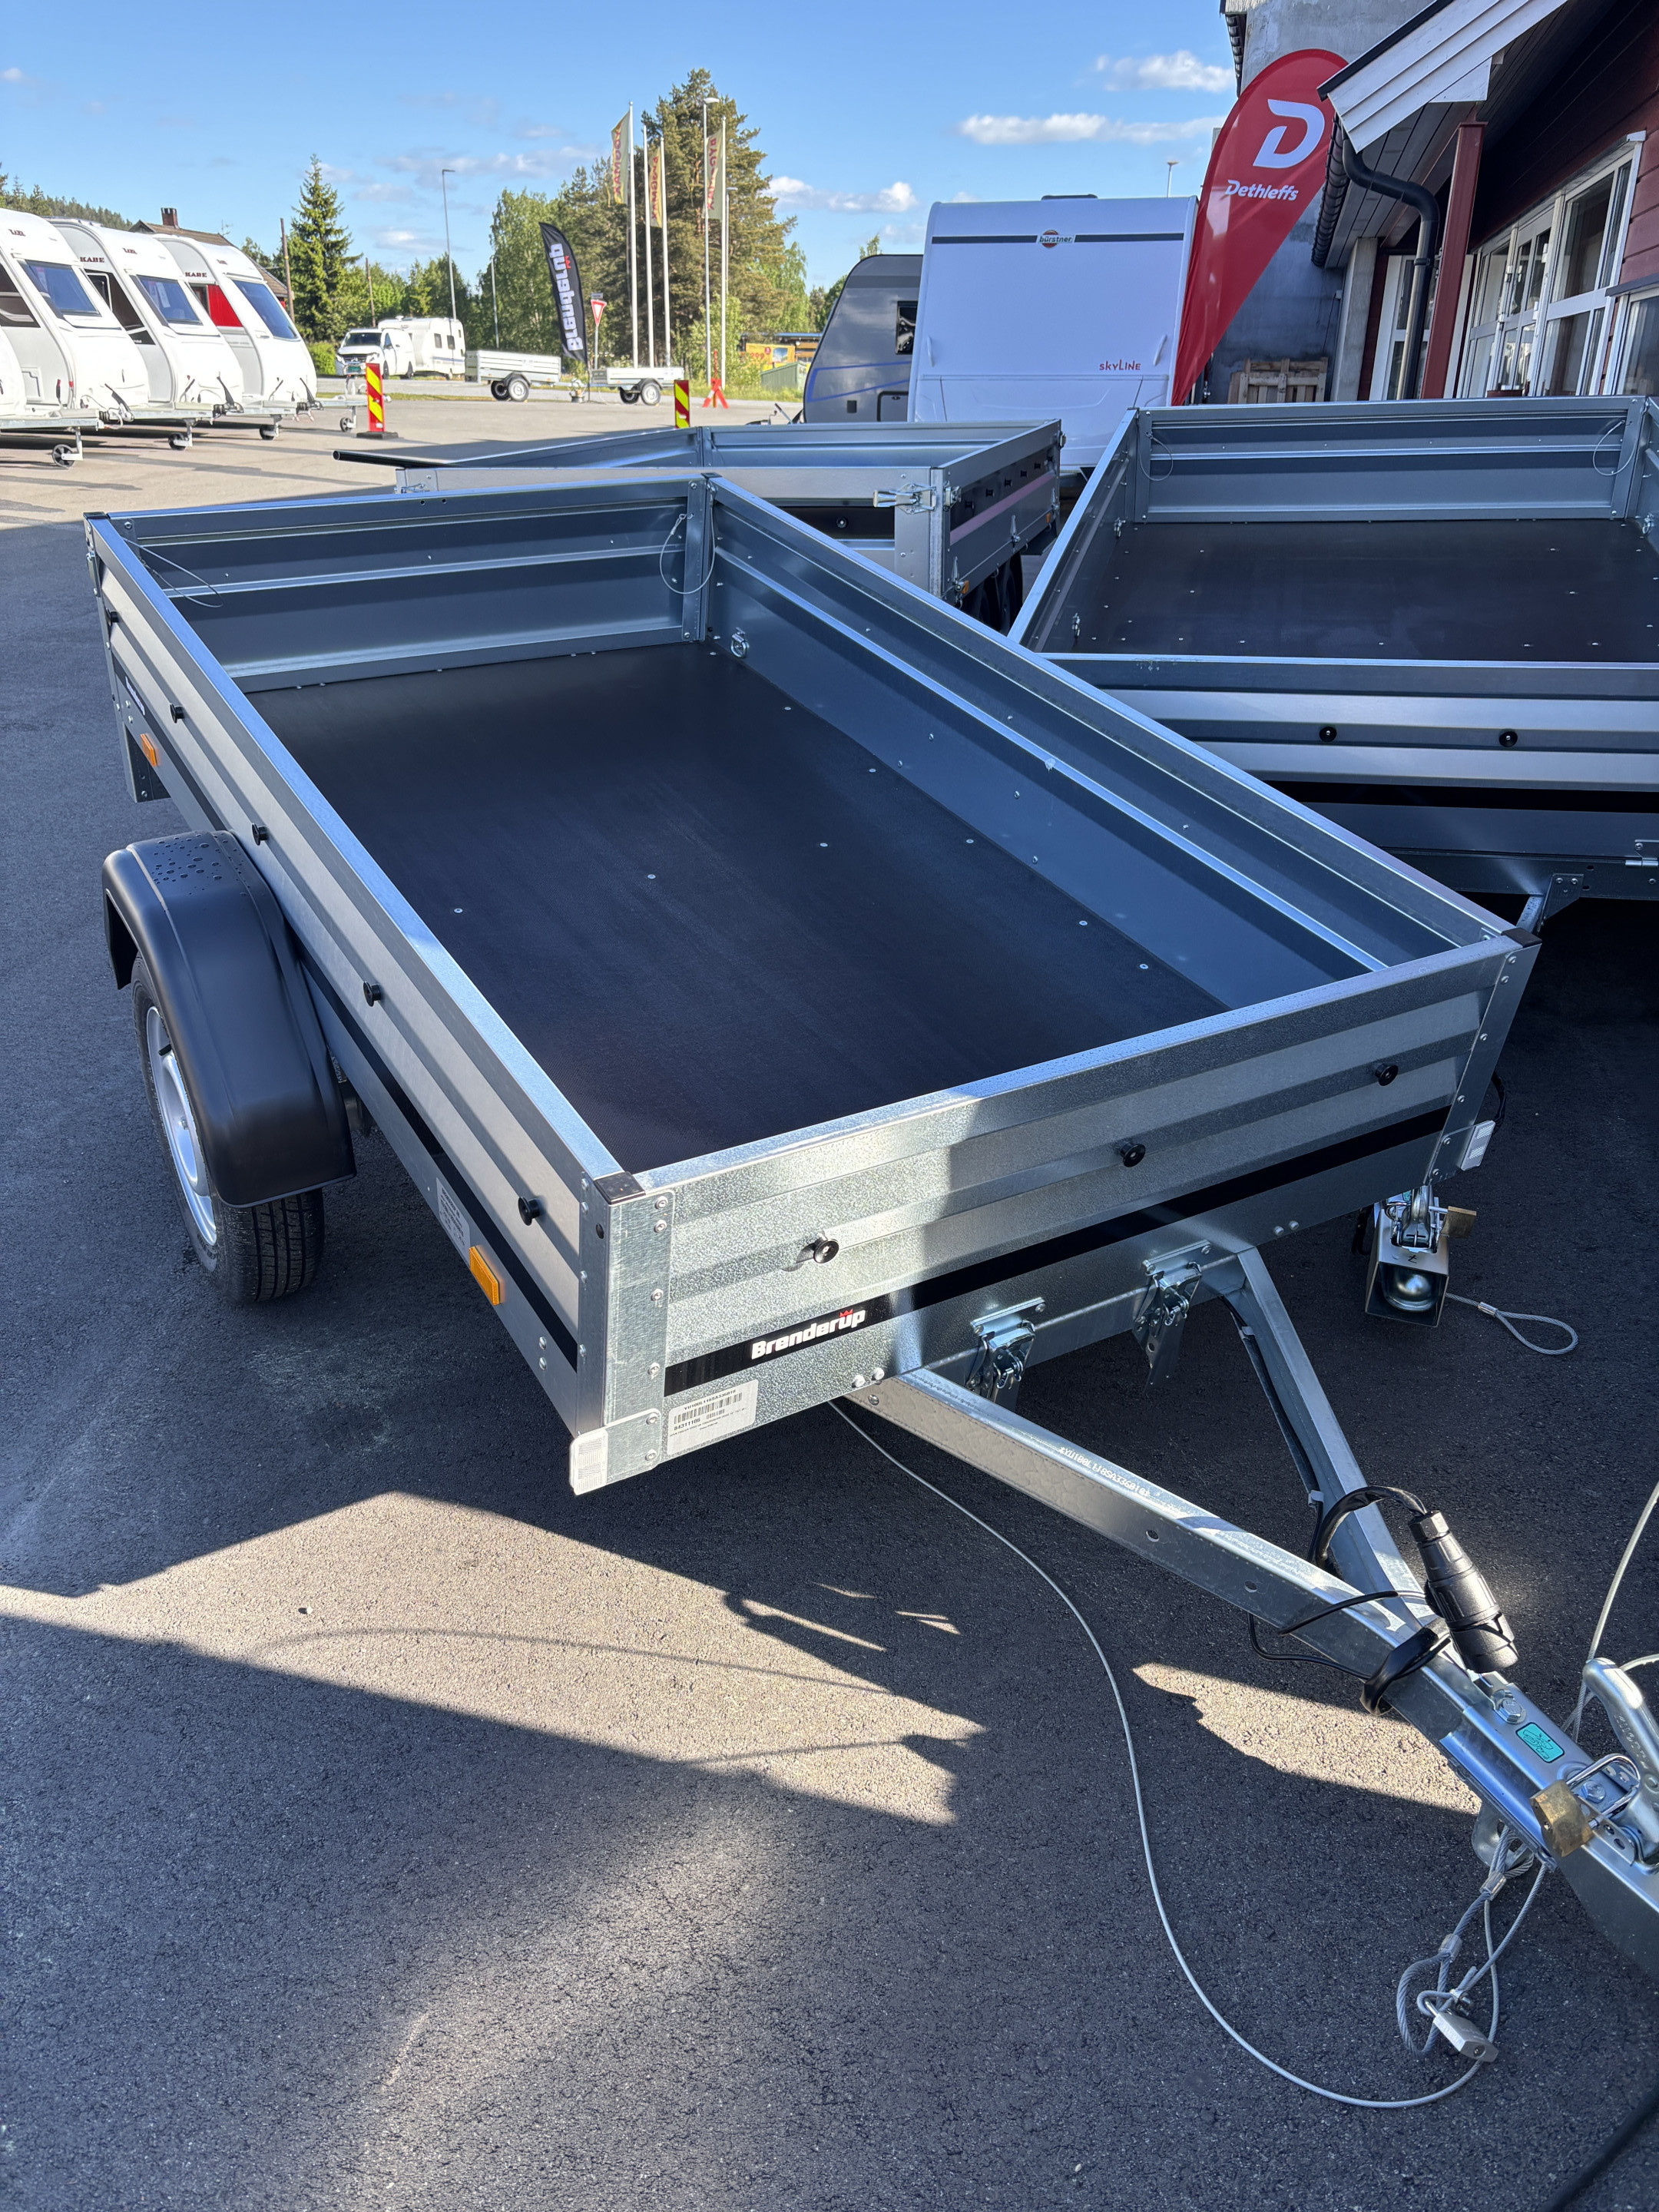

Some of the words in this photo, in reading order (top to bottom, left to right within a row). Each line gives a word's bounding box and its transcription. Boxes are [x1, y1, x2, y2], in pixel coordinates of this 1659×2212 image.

[1252, 98, 1325, 169] D
[1224, 179, 1299, 201] Dethleffs
[750, 1309, 866, 1360] Brenderup
